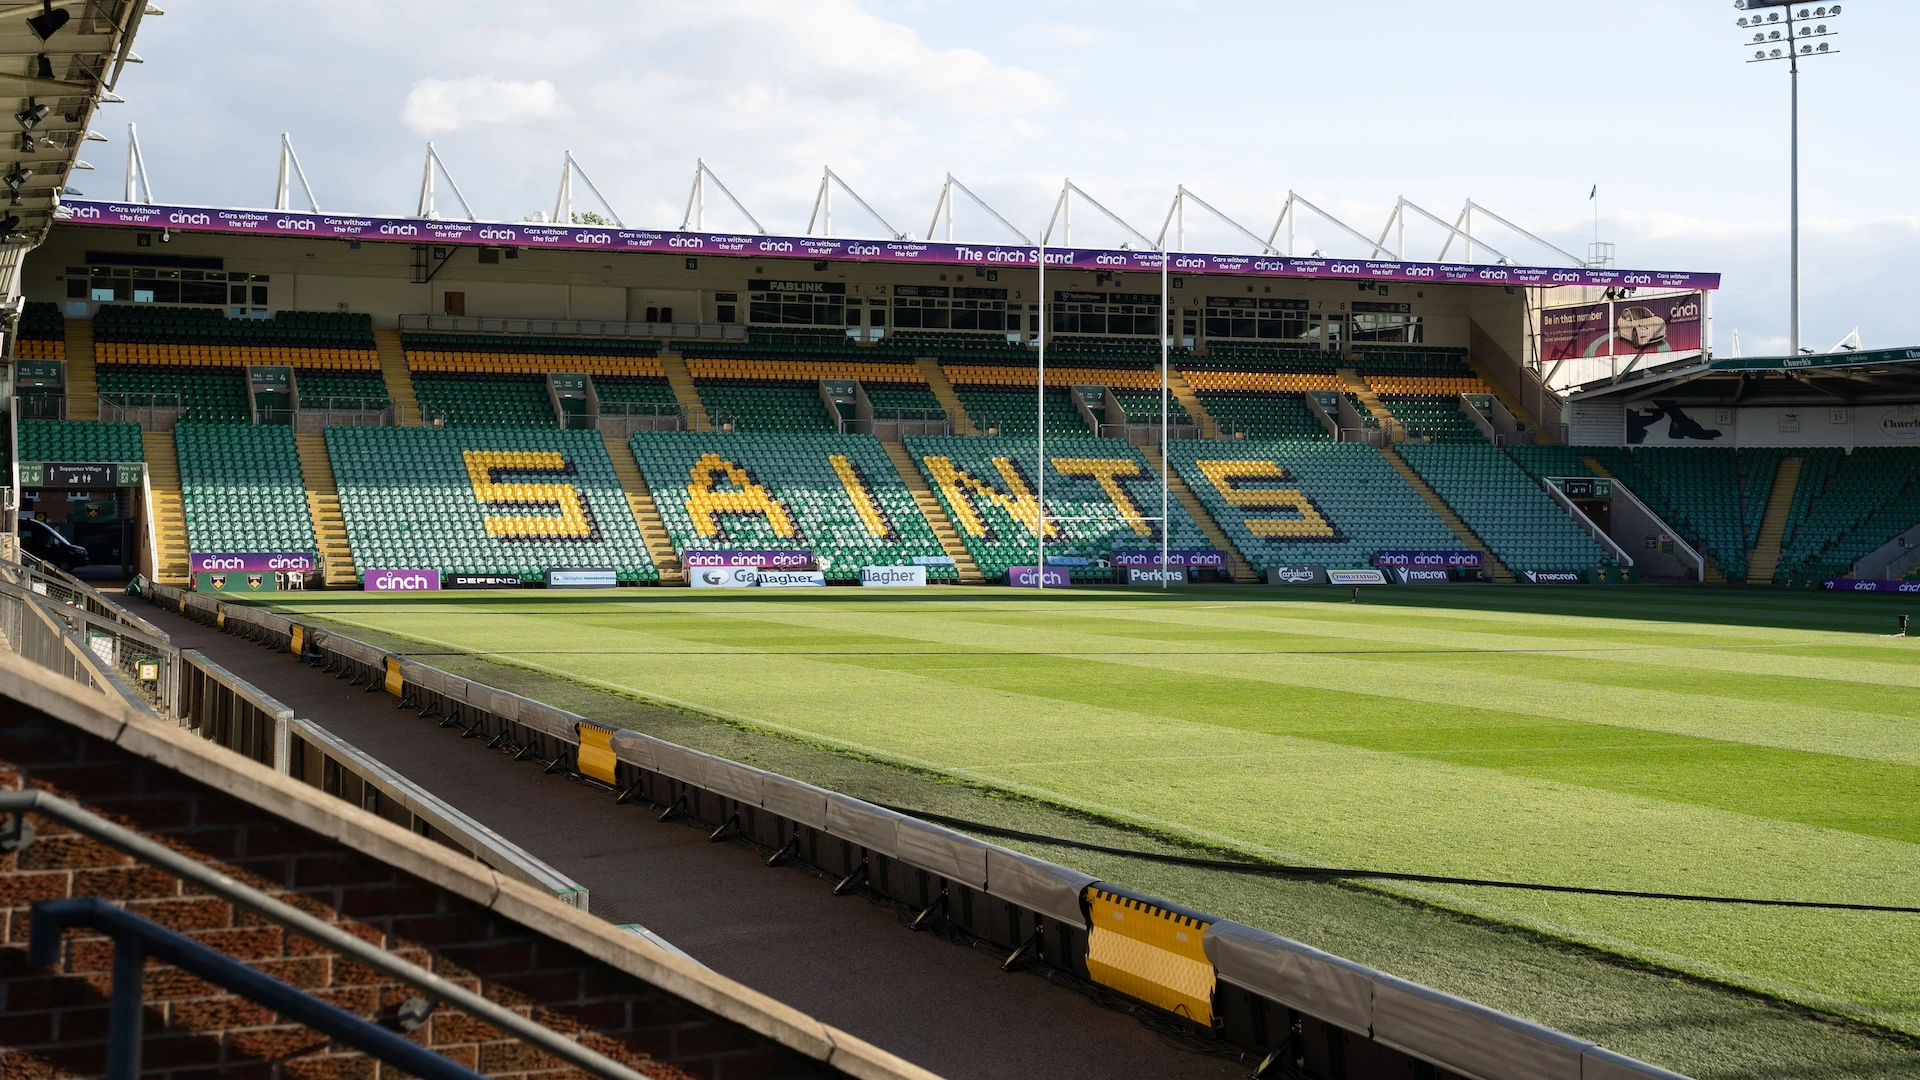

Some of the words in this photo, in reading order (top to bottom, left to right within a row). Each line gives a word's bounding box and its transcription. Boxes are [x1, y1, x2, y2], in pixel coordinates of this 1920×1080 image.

[130, 206, 160, 215] without
[237, 213, 268, 221] without
[133, 214, 150, 222] faff
[170, 210, 210, 225] cinch
[277, 216, 315, 230] cinch
[342, 219, 371, 227] without
[380, 221, 417, 235] cinch
[443, 223, 471, 232] without
[480, 226, 515, 240] cinch
[576, 231, 610, 244] cinch
[635, 232, 661, 240] without
[669, 235, 703, 248] cinch
[760, 238, 792, 252] cinch
[816, 240, 840, 248] without
[848, 243, 880, 255] cinch
[955, 247, 982, 261] The
[987, 247, 1025, 263] cinch
[1097, 252, 1126, 265] cinch
[1176, 255, 1205, 268] cinch
[1255, 259, 1283, 271] cinch
[1331, 261, 1359, 274] cinch
[1406, 264, 1434, 277] cinch
[1480, 267, 1507, 280] cinch
[1553, 270, 1580, 282] cinch
[1624, 272, 1651, 284] cinch
[770, 281, 823, 292] FABLINK
[1670, 302, 1698, 318] cinch
[1545, 315, 1552, 325] Be
[1553, 315, 1560, 324] in
[1560, 314, 1575, 323] that
[1577, 311, 1603, 322] number
[1783, 358, 1811, 367] Church's
[462, 450, 1338, 540] SAINTS
[203, 555, 244, 569] cinch
[268, 554, 309, 568] cinch
[689, 552, 723, 565] cinch
[731, 552, 765, 565] cinch
[773, 552, 807, 565] cinch
[1116, 552, 1147, 564] cinch
[1190, 552, 1221, 564] cinch
[1414, 552, 1443, 564] cinch
[1449, 552, 1477, 564] cinch
[376, 572, 427, 589] cinch
[1130, 569, 1182, 580] Perkns
[1279, 567, 1313, 582] Carlsberg
[1410, 570, 1446, 579] macron
[1854, 580, 1876, 590] cinch
[143, 665, 154, 679] B
